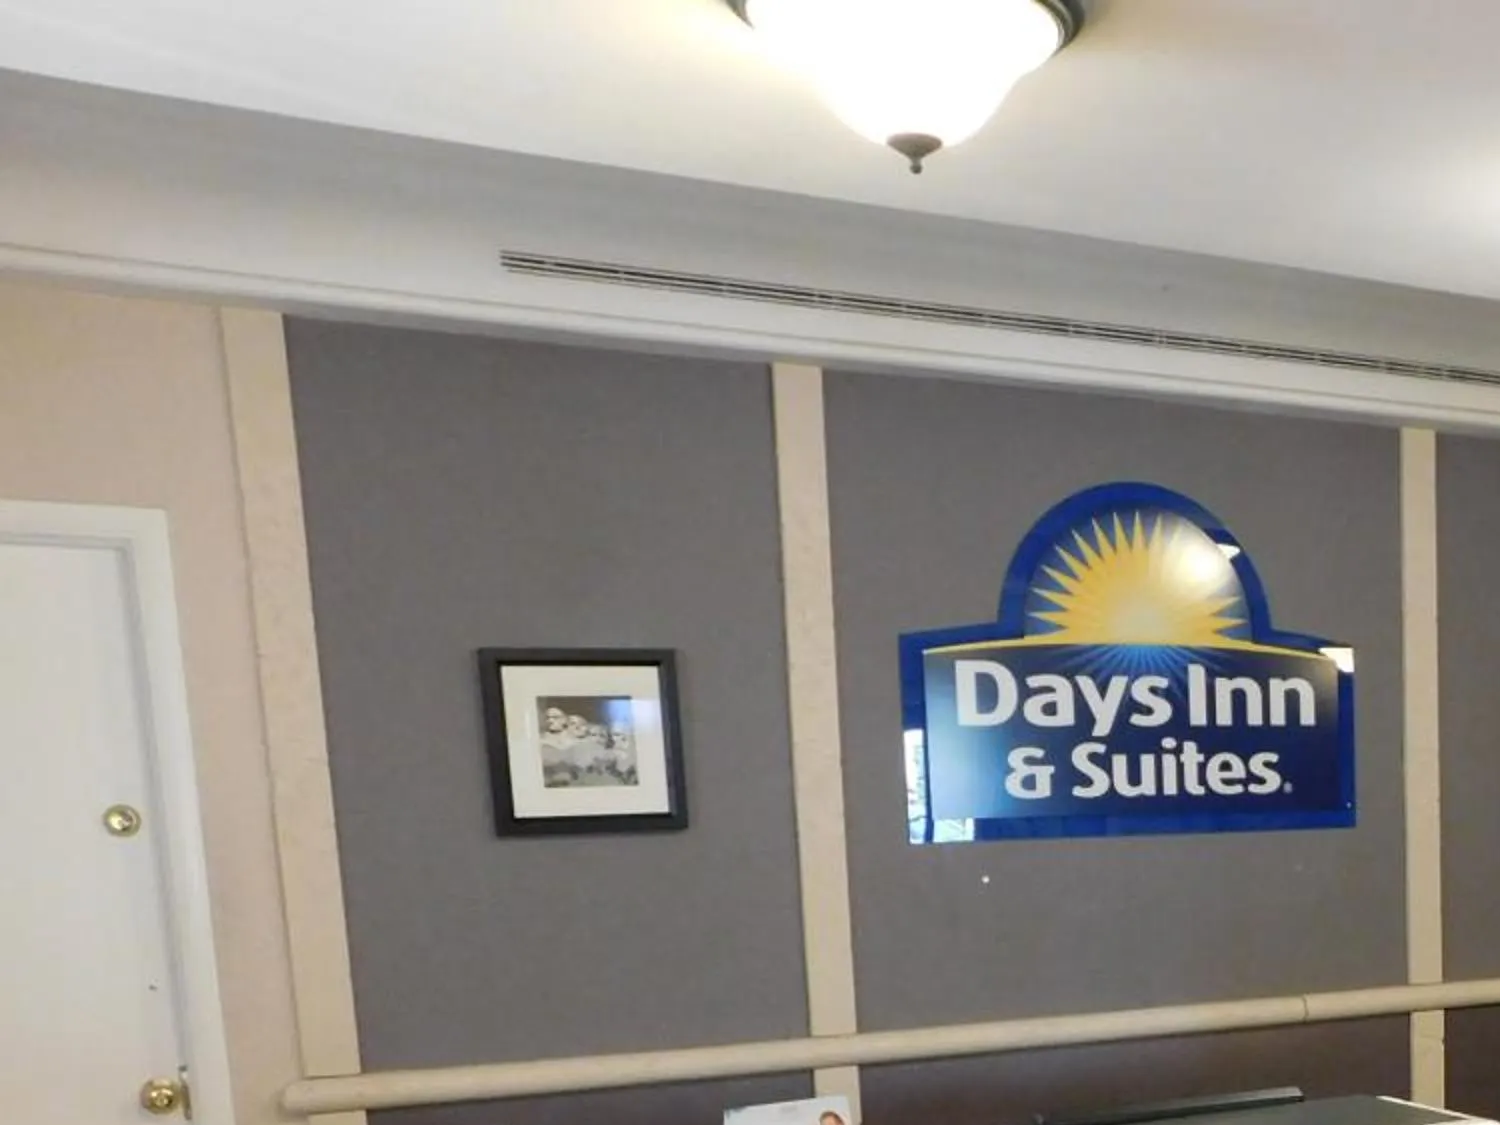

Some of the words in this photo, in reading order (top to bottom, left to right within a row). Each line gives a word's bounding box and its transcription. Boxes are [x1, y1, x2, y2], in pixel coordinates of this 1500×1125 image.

[955, 660, 1173, 737] Days
[1187, 664, 1316, 726] Inn
[1005, 746, 1055, 800] &
[1070, 737, 1282, 798] Suites
